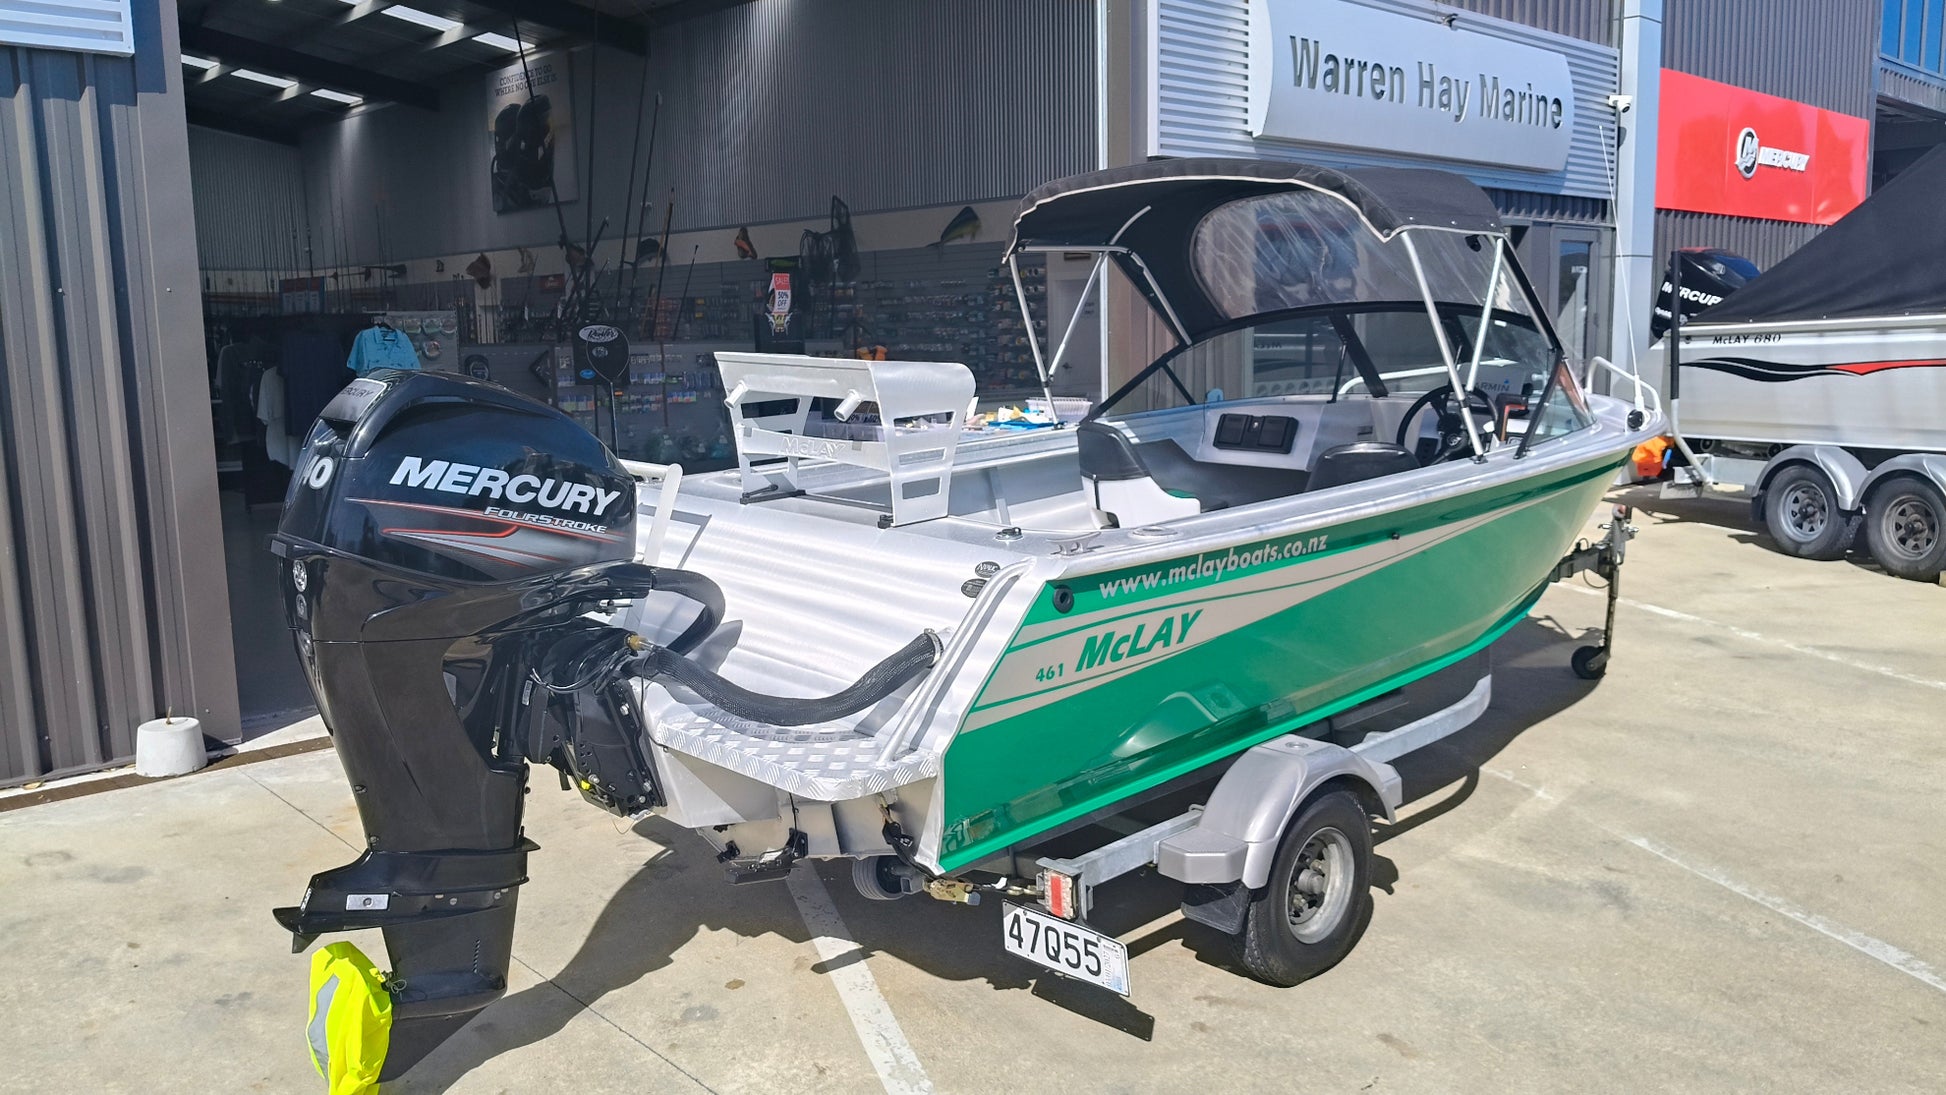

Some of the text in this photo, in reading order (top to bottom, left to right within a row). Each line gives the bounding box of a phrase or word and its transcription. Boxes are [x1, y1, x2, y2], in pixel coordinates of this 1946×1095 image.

[1290, 35, 1564, 130] Warren Hay Marine
[1758, 145, 1810, 172] MERCURY
[777, 290, 789, 300] 50%
[777, 299, 787, 307] OFF
[1712, 332, 1782, 346] McLAY 680
[777, 436, 846, 459] McLAY
[389, 456, 621, 516] MERCURY
[484, 506, 608, 535] FOURSTROKE
[1099, 532, 1328, 599] www.mclayboats.co.nz
[1035, 609, 1204, 684] 461 McLAY
[1008, 912, 1102, 977] 47Q55
